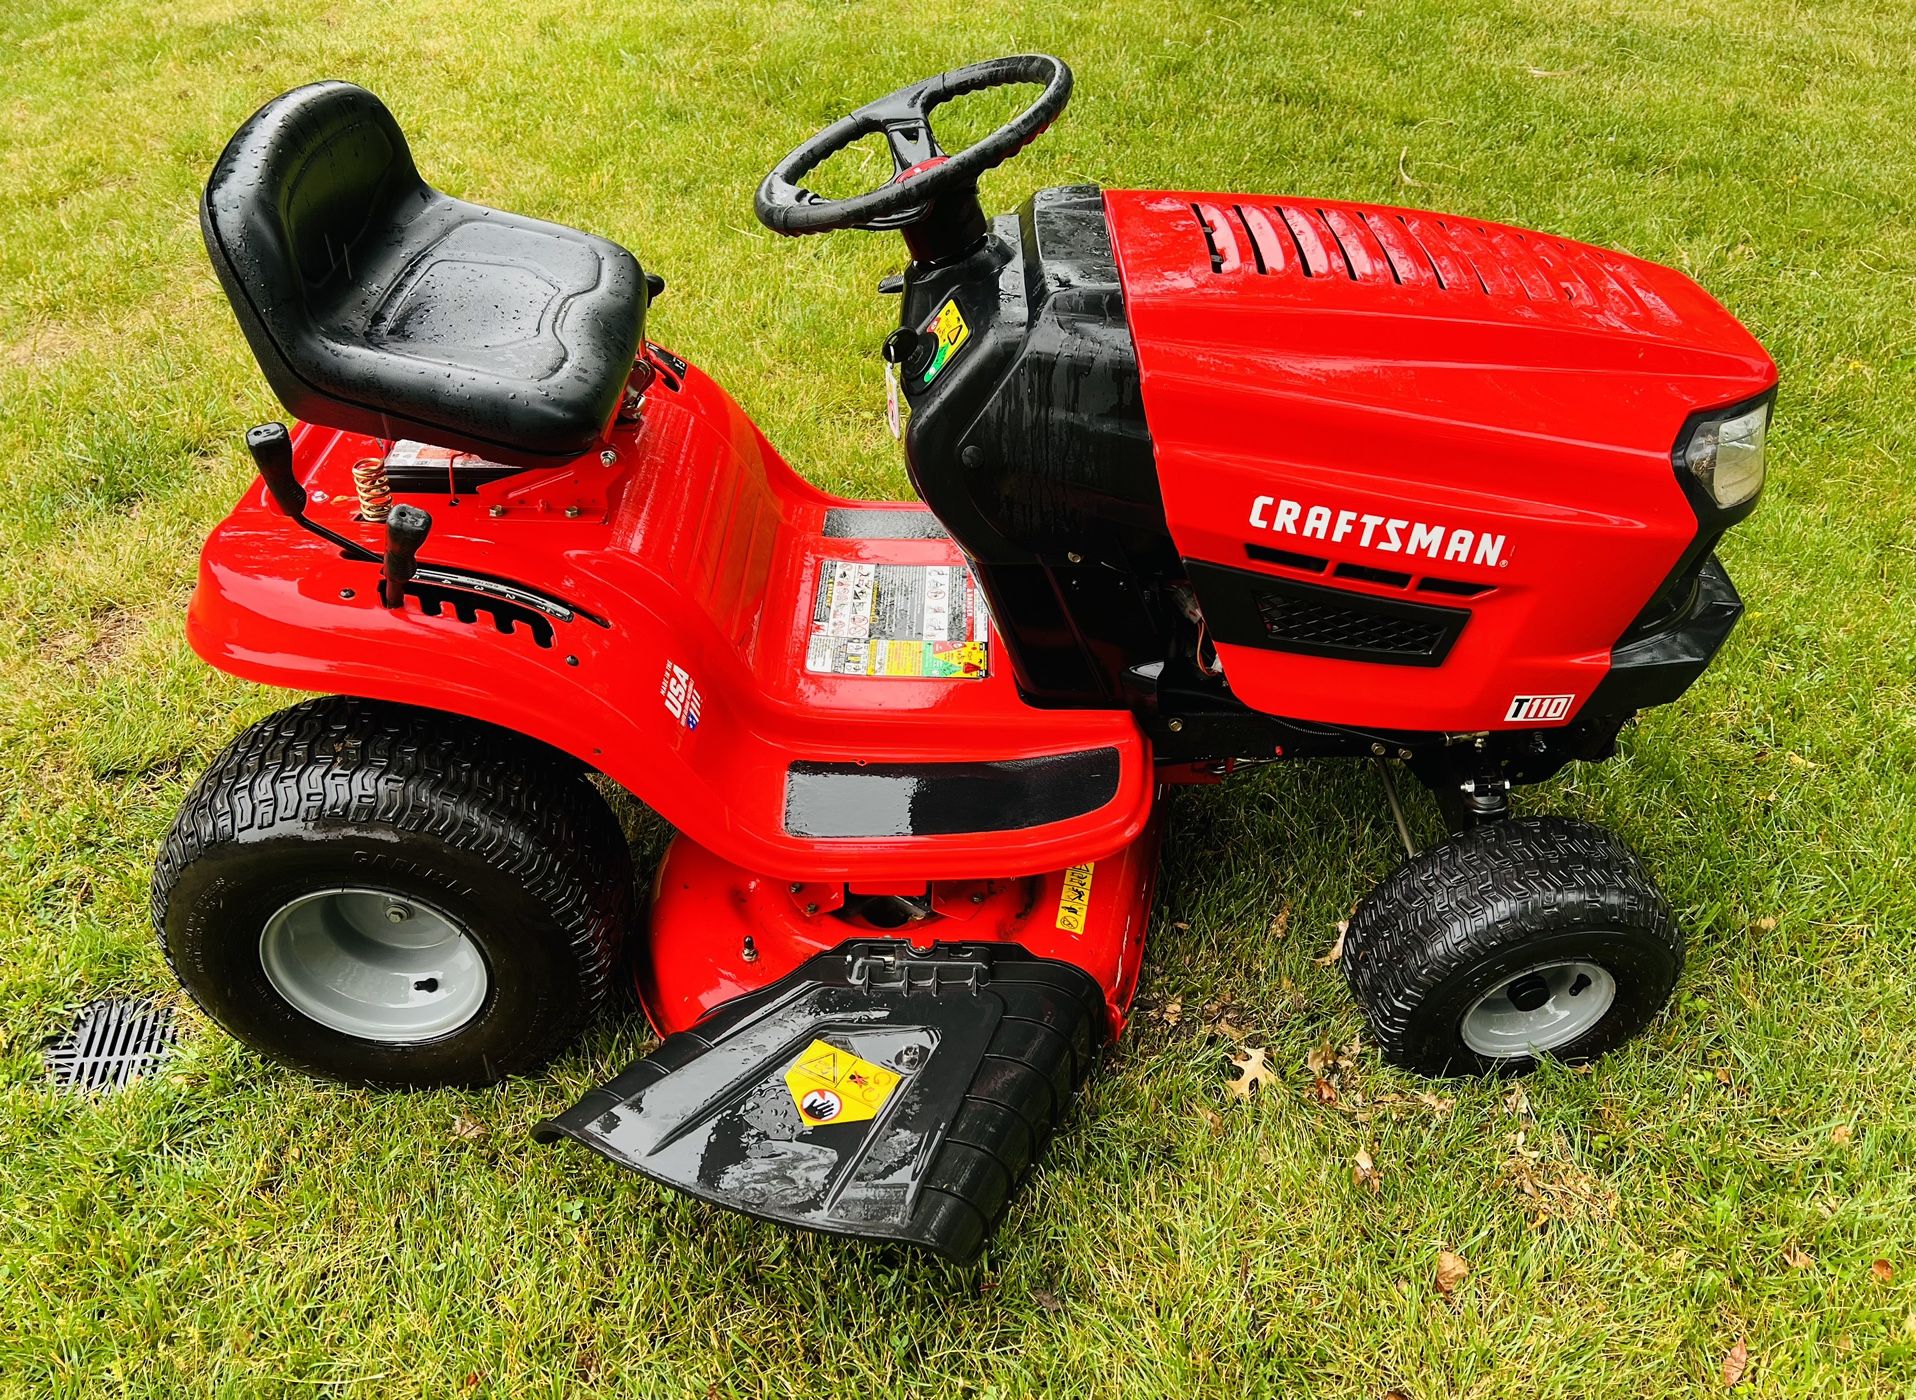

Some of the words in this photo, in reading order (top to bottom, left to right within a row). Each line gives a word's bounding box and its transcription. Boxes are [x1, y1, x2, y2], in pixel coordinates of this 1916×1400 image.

[1249, 495, 1505, 567] CRAFTSMAN
[505, 592, 516, 600] 2
[664, 663, 689, 719] USA
[1510, 697, 1570, 719] T110
